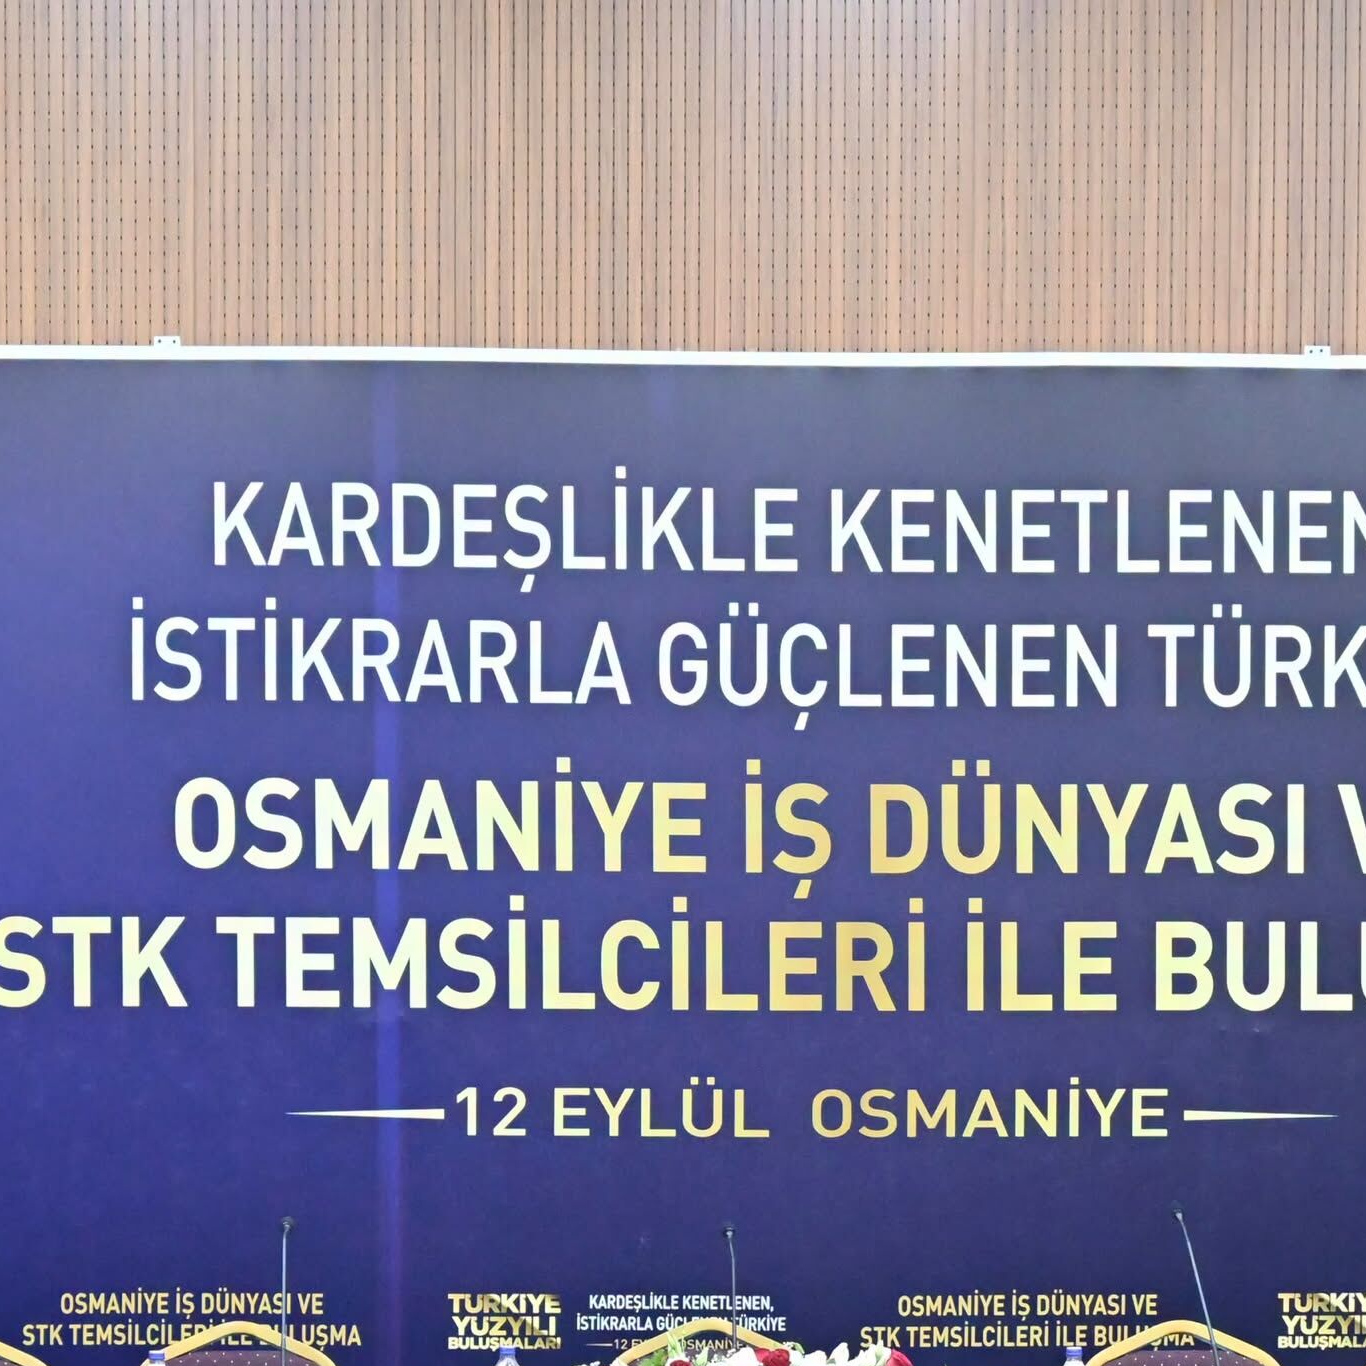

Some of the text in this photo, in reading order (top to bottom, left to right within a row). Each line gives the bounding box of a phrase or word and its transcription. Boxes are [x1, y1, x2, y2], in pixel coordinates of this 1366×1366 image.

[213, 465, 799, 593] KARDEŞLİKLE
[131, 596, 632, 705] İSTİKRARLA
[658, 601, 1118, 731] GÜÇLENEN
[174, 756, 707, 873] OSMANİYE
[745, 758, 832, 900] İŞ
[869, 759, 1305, 875] DÜNYASI
[215, 888, 926, 1012] TEMSİLCİLERİ
[966, 897, 1118, 1012] İLE
[456, 1076, 1169, 1138] 12 EYLÜL OSMANİYE
[60, 1286, 324, 1320] OSMANİYE İŞ DÜNYASI VE
[860, 1320, 1088, 1349] STK TEMSİLCİLERİ İLE
[897, 1288, 1158, 1322] OSMANİYE İŞ DÜNYASI VE
